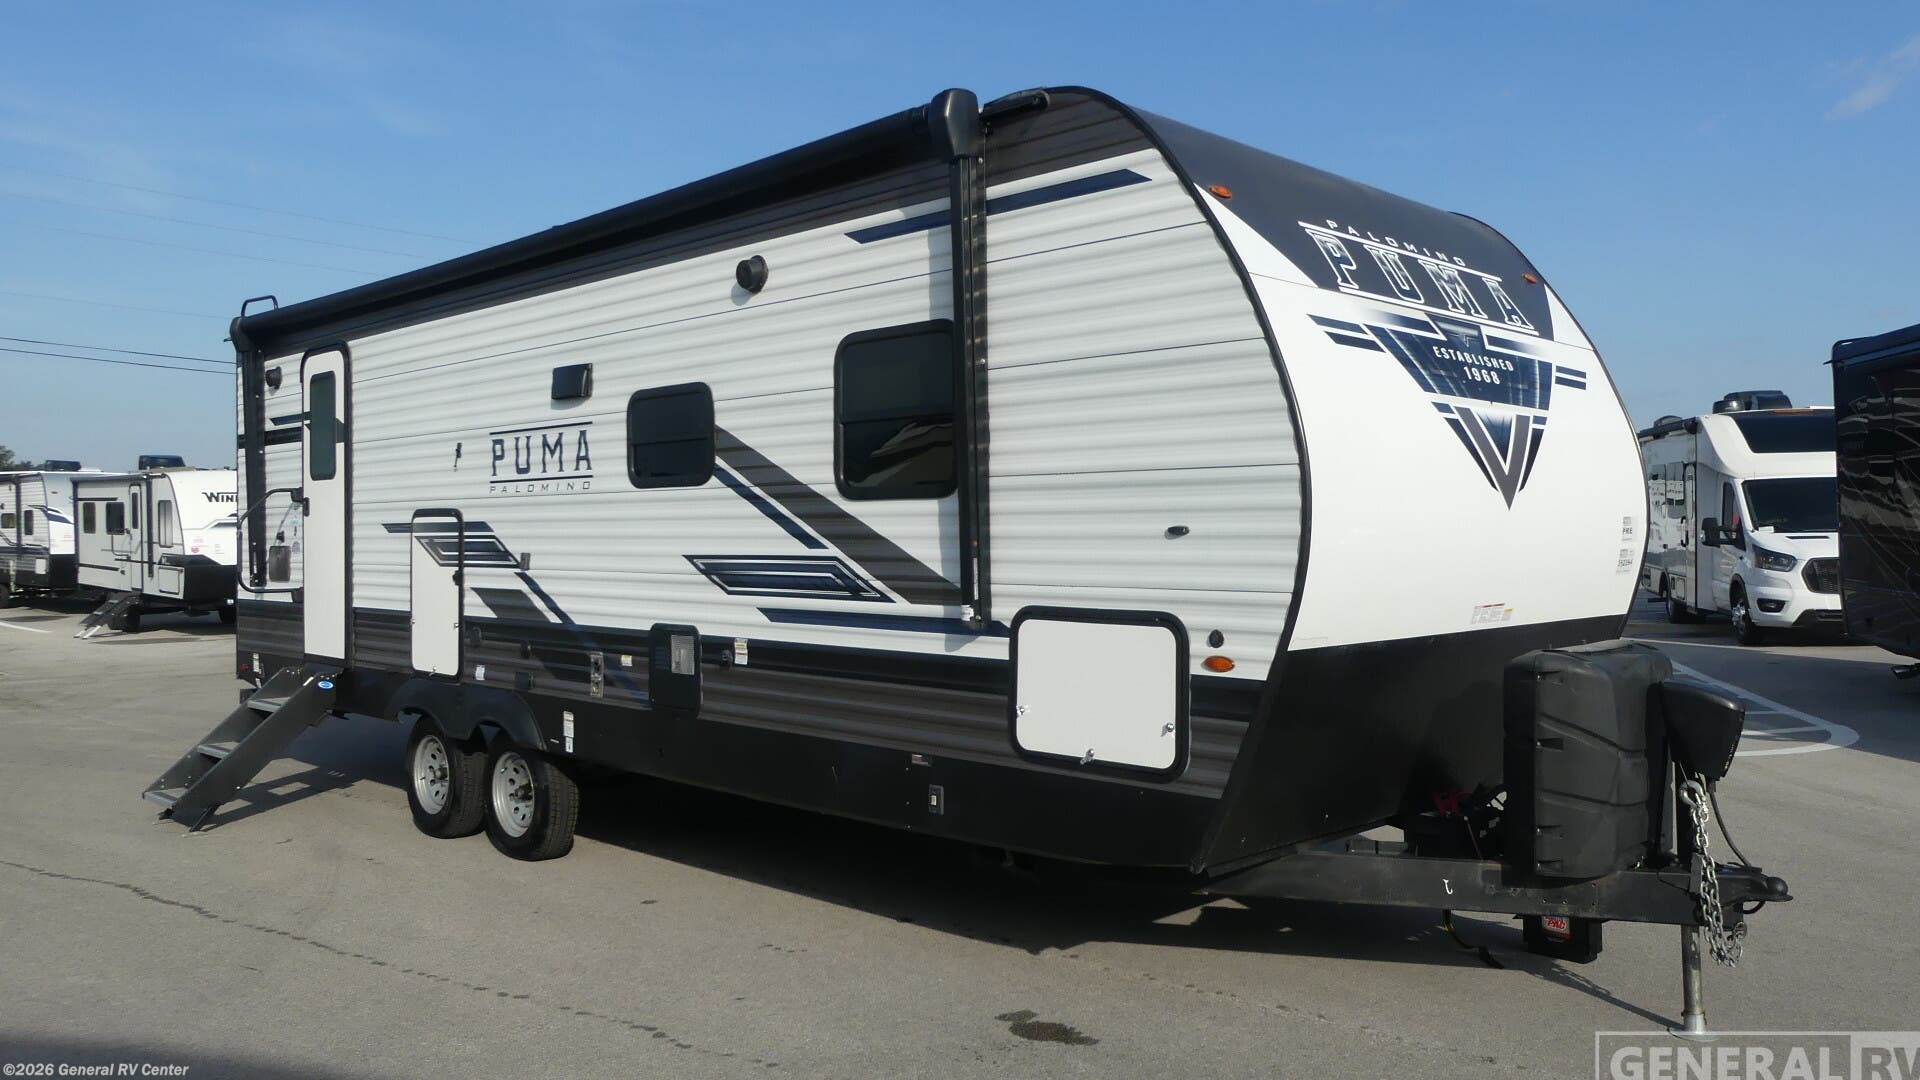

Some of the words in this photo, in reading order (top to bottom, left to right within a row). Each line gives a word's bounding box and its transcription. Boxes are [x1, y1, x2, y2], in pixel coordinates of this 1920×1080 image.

[1326, 219, 1467, 267] PALOMINO
[1305, 228, 1535, 330] PUMA
[1432, 345, 1514, 372] ESTABLISHED
[1463, 365, 1502, 386] 1968
[492, 429, 593, 477] PUMA
[202, 491, 238, 503] WIN
[490, 481, 591, 494] PALOMINO
